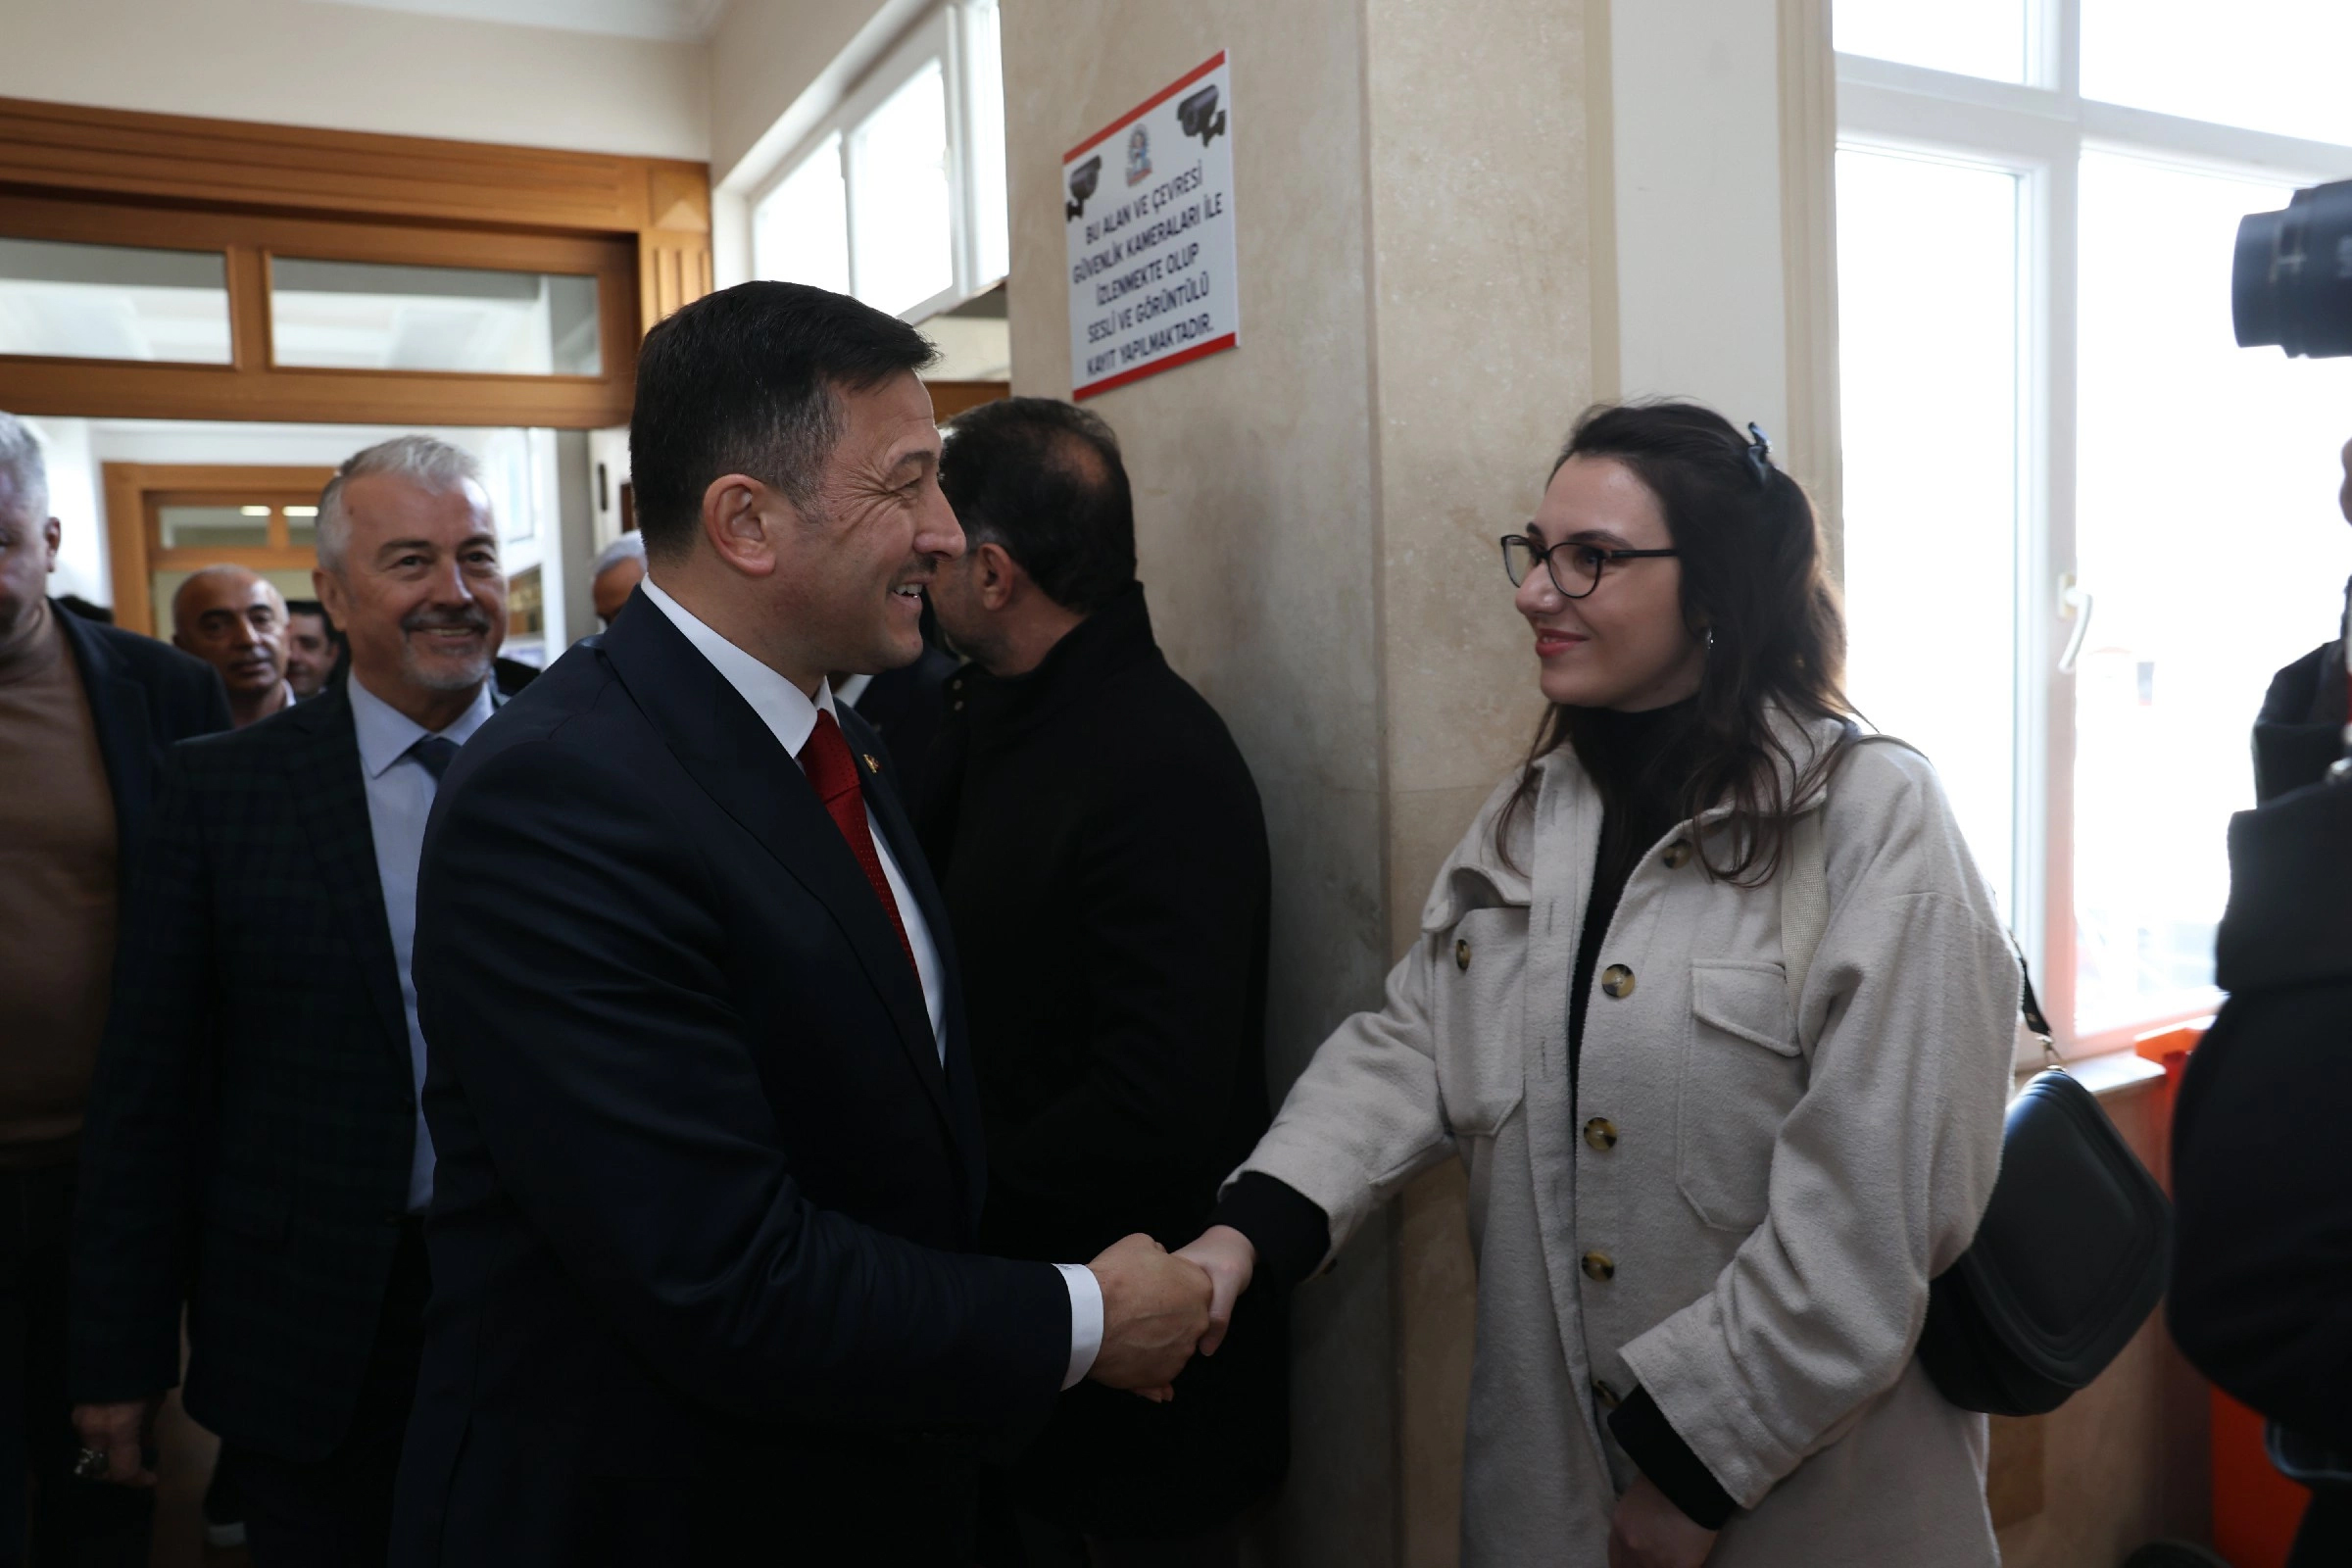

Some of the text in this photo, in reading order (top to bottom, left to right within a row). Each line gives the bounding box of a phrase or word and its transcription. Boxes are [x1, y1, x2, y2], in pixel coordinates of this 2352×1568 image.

[1073, 192, 1222, 284] GÜVENLİK KAMERALARI İLE
[1086, 159, 1202, 244] BU ALAN VE ÇEVRESİ
[1088, 270, 1209, 343] SESLİ VE GÖRÜNTÜLÜ
[1096, 242, 1200, 306] İZLENMEKTE OLUP
[1087, 349, 1115, 376] KAYIT
